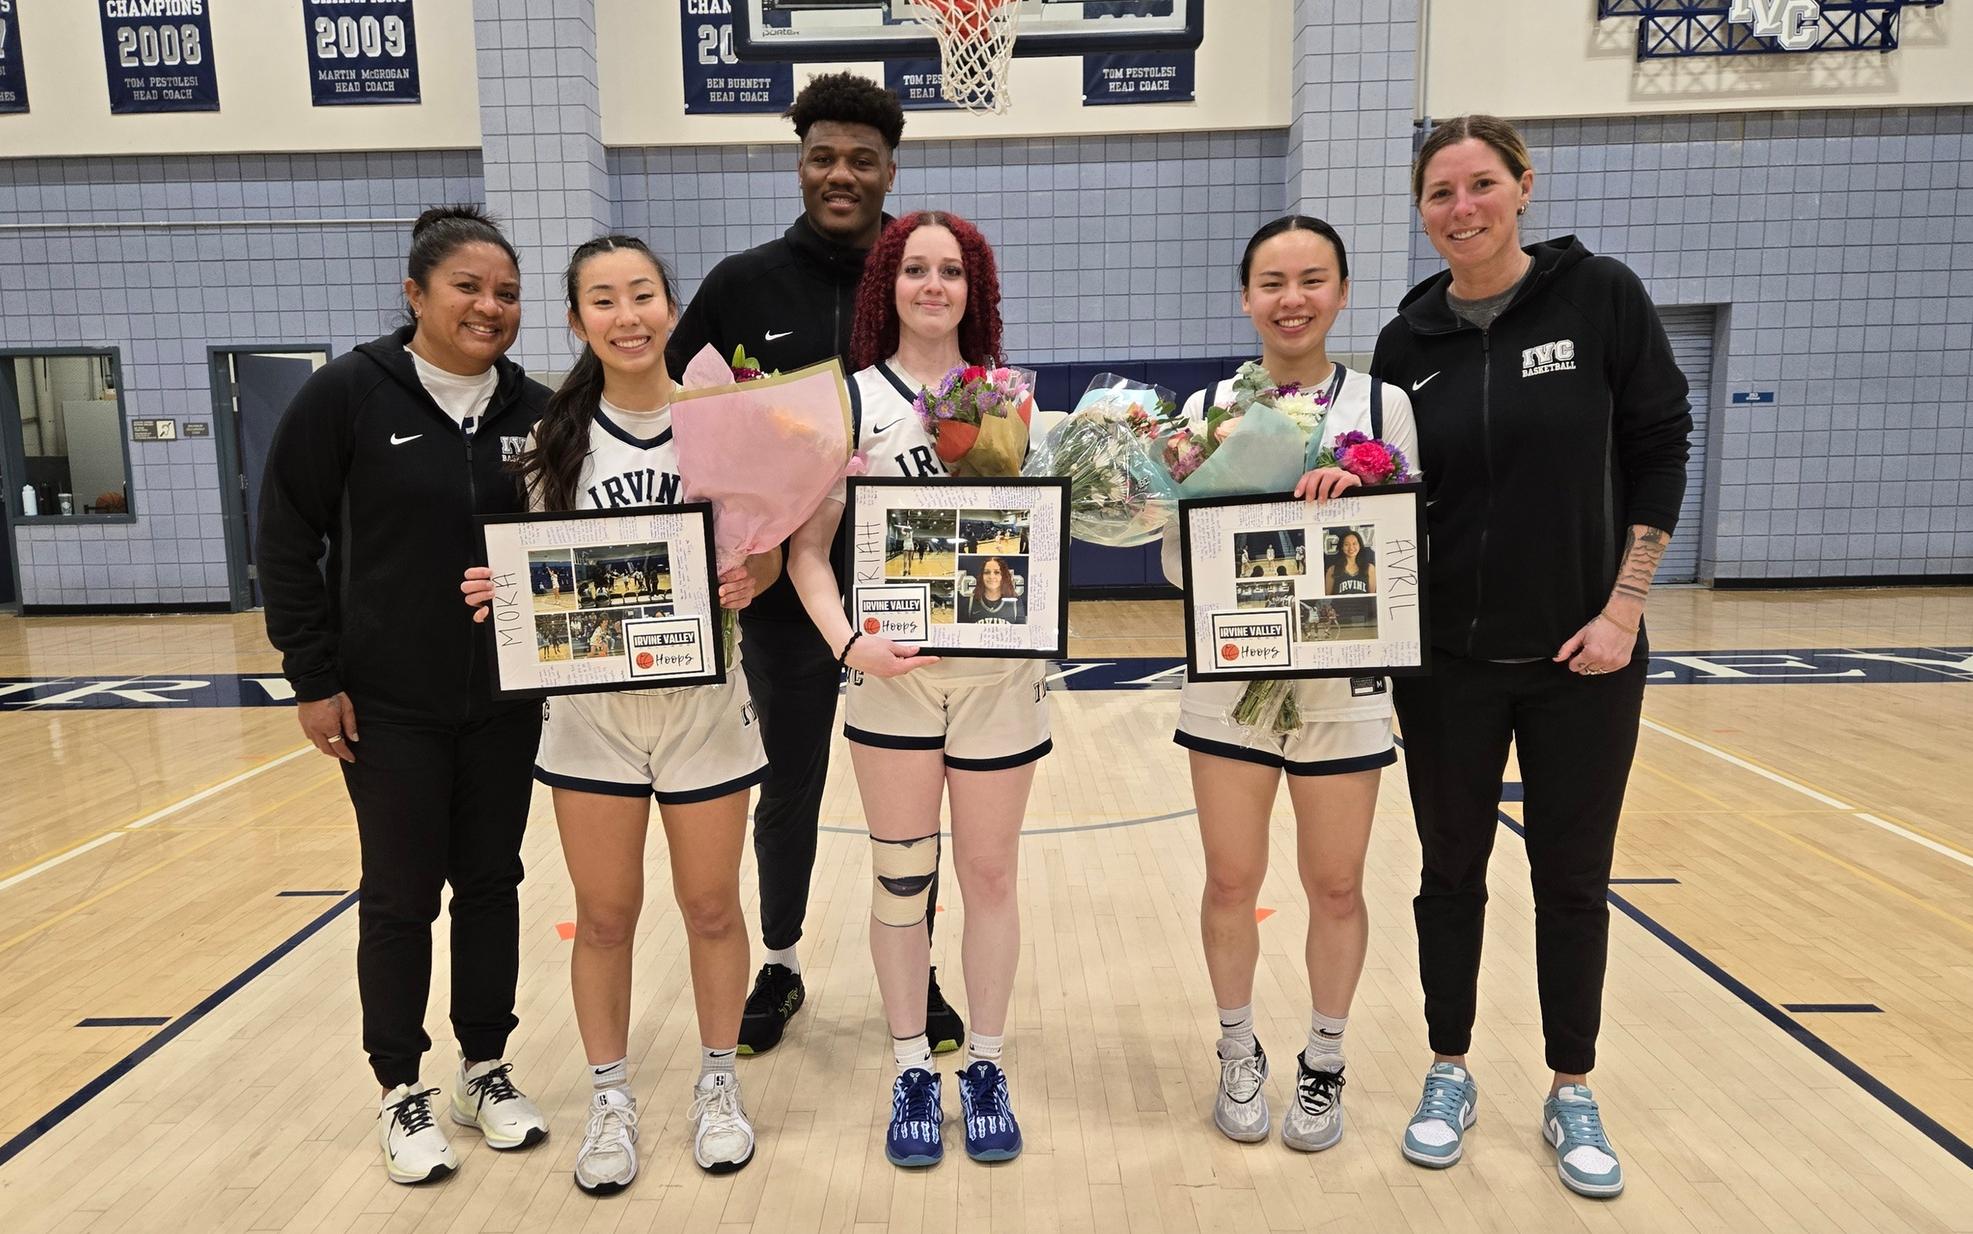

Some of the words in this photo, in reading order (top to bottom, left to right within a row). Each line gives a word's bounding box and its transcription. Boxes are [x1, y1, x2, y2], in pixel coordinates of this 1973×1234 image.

[107, 0, 203, 17] CHAMPIONS
[315, 15, 406, 58] 2009
[117, 24, 202, 67] 2008
[318, 69, 356, 80] MARTIN
[1103, 68, 1123, 79] TOM
[1126, 66, 1176, 78] PESTOLESI
[124, 77, 145, 88] TOM
[150, 76, 199, 87] PESTOLESI
[335, 82, 360, 92] HEAD
[365, 81, 395, 91] COACH
[706, 79, 725, 89] BEN
[728, 78, 771, 88] BURNETT
[903, 75, 924, 86] TOM
[1109, 81, 1134, 92] HEAD
[1139, 80, 1170, 91] COACH
[133, 90, 158, 100] HEAD
[163, 89, 193, 99] COACH
[709, 92, 735, 102] HEAD
[740, 91, 769, 102] COACH
[909, 88, 935, 99] HEAD
[1522, 339, 1575, 369] IVC
[1522, 361, 1576, 378] BASKETBALL
[587, 468, 684, 509] IRVIN
[1385, 539, 1418, 621] AVRIL
[492, 573, 523, 647] MOKA
[863, 600, 889, 611] IRVINE
[890, 600, 920, 610] VALLEY
[882, 620, 918, 634] Hoops
[1220, 626, 1248, 637] IRVINE
[1249, 625, 1281, 636] VALLEY
[634, 634, 662, 646] IRVINE
[663, 632, 694, 643] VALLEY
[1241, 646, 1280, 660] Hoops
[655, 653, 693, 667] Hoops
